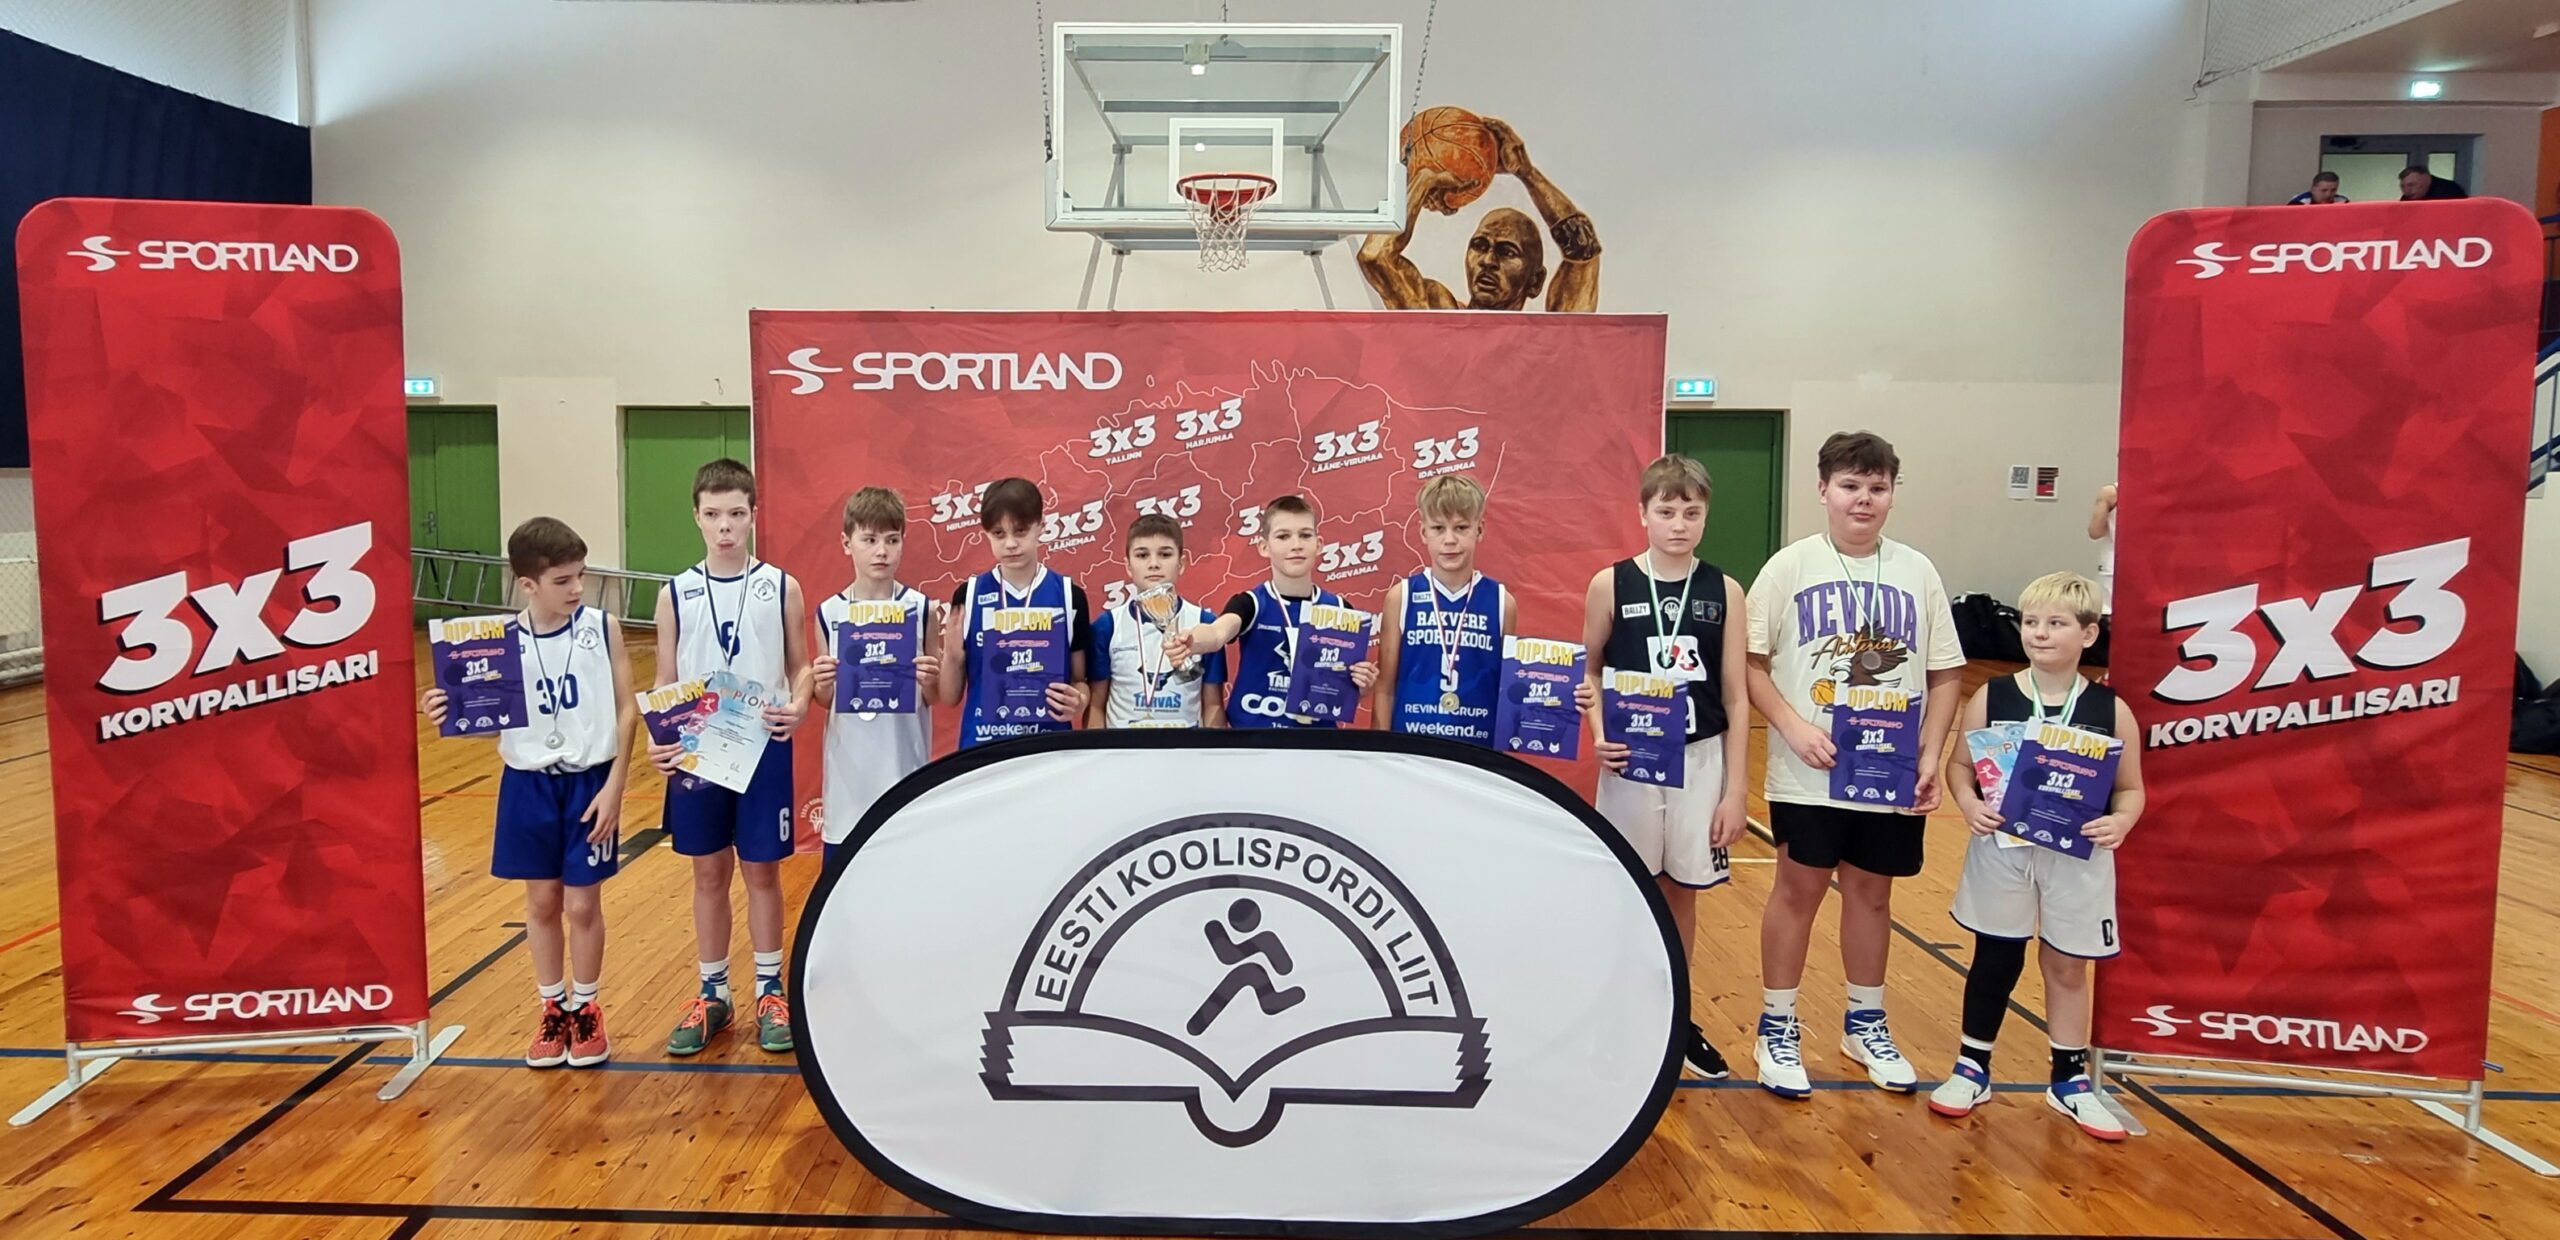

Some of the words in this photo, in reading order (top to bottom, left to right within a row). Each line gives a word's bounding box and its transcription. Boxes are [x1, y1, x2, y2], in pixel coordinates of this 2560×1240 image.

[138, 240, 359, 273] SPORTLAND
[2248, 236, 2492, 273] SPORTLAND
[852, 351, 1122, 391] SPORTLAND
[1088, 415, 1156, 457] 3x3
[1174, 398, 1242, 440] 3x3
[1105, 450, 1142, 465] TALLINN
[1185, 432, 1234, 450] HARJUMAA
[1312, 420, 1379, 462] 3x3
[1412, 427, 1479, 469] 3x3
[1418, 461, 1476, 479] IDA-VIRUMAA
[1038, 500, 1104, 542] 3x3
[1317, 530, 1384, 572] 3x3
[98, 520, 376, 693] 3x3
[848, 603, 905, 624] DIPLOM
[993, 610, 1053, 631] DIPLOM
[1309, 605, 1361, 633] DIPLOM
[1416, 611, 1488, 630] RAKVERE
[1624, 605, 1647, 616] BALLZY
[2151, 536, 2471, 702] 3x3
[443, 620, 506, 643] DIPLOM
[1515, 639, 1574, 666] DIPLOM
[1440, 653, 1460, 693] 5
[1614, 673, 1676, 699] DIPLOM
[99, 649, 379, 741] KORVPALLISARI
[536, 673, 579, 715] 30
[648, 679, 706, 712] DIPLOM
[1404, 703, 1438, 714] REVIN
[1847, 689, 1910, 713] DIPLOM
[2149, 675, 2461, 749] KORVPALLISARI
[2036, 724, 2109, 761] DIPLOM
[779, 807, 790, 842] 6
[587, 832, 614, 867] 30
[1710, 847, 1729, 872] 28
[1034, 886, 1117, 1003] EESTI
[1116, 836, 1397, 932] KOOLISPORDI
[1386, 931, 1439, 1007] LIIT
[183, 984, 393, 1022] SPORTLAND
[2199, 1011, 2429, 1054] SPORTLAND
